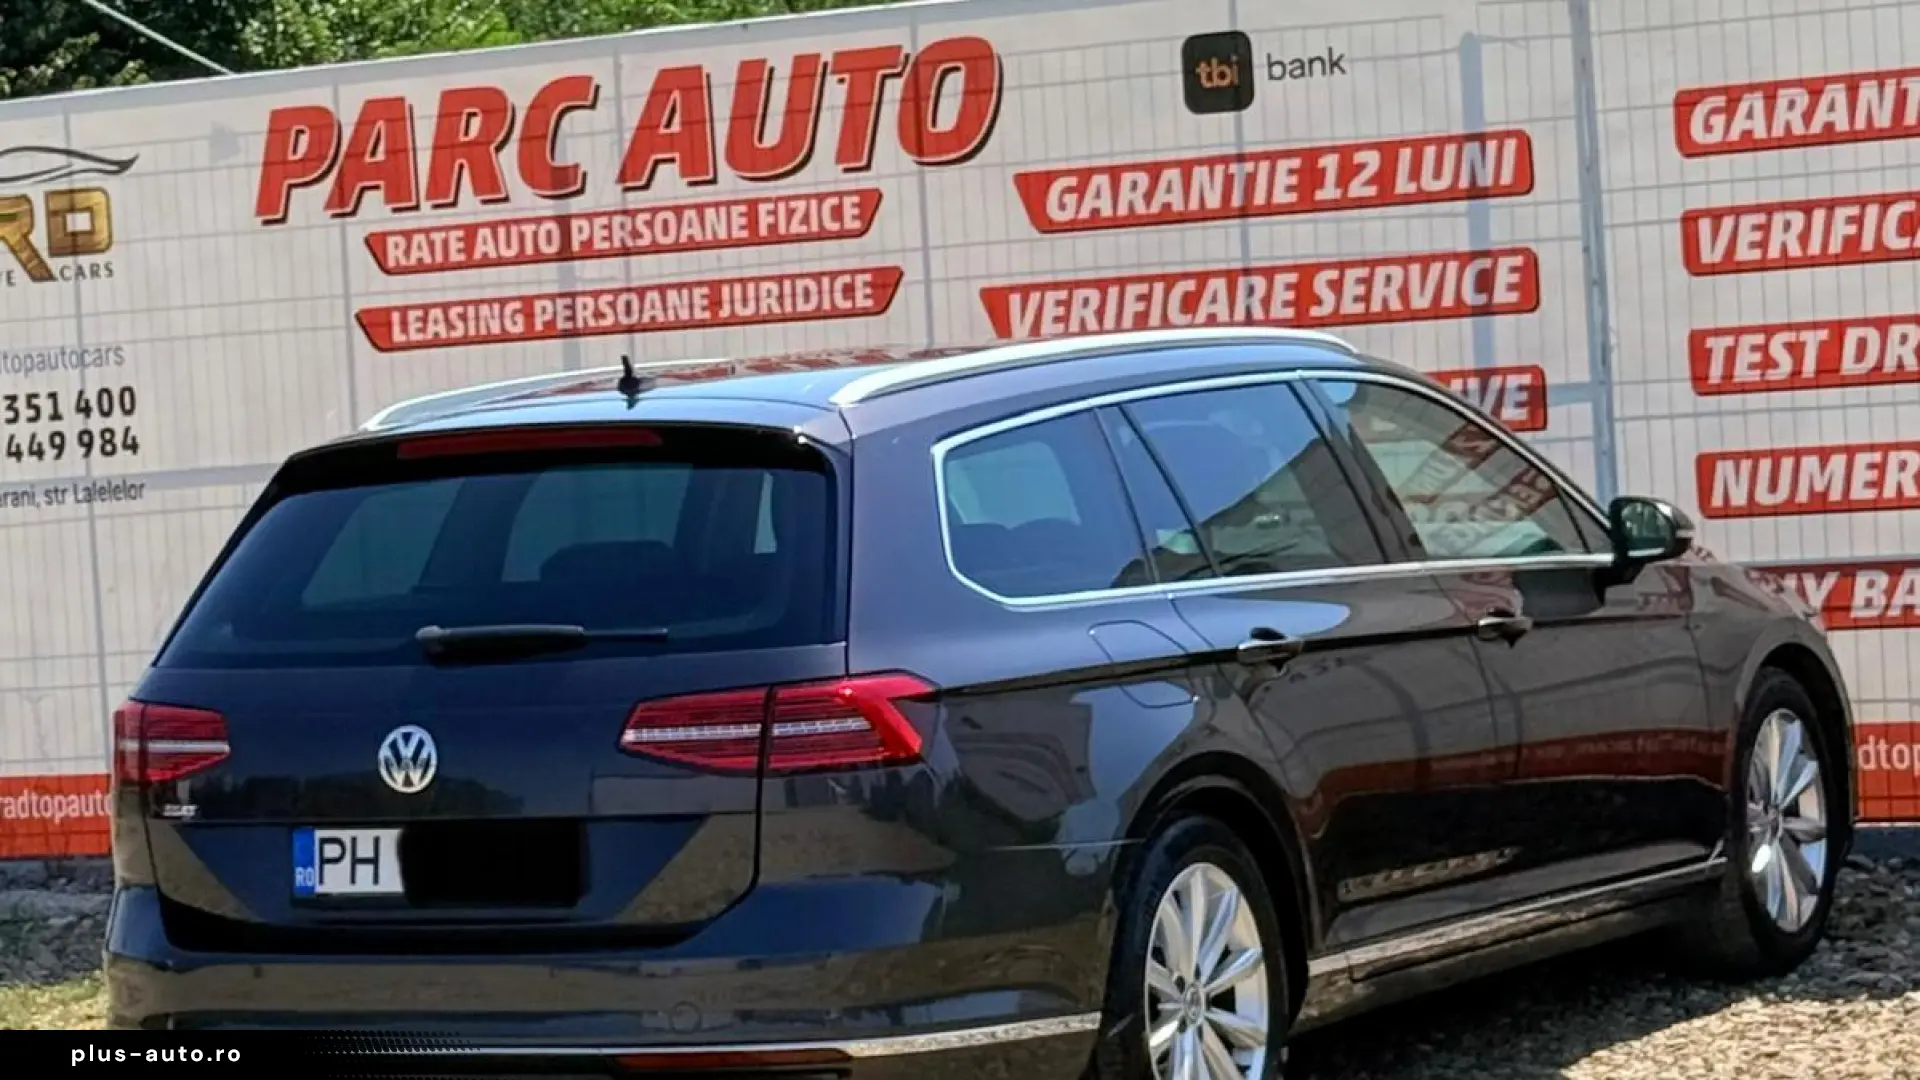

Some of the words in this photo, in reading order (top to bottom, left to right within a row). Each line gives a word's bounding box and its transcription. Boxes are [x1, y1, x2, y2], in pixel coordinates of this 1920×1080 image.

[1196, 56, 1239, 89] tbi
[1267, 46, 1347, 81] bank
[254, 75, 602, 225] PARC
[615, 36, 1003, 192] AUTO
[1045, 157, 1302, 222] GARANTIE
[1313, 146, 1380, 201] 12
[1393, 136, 1518, 196] LUNI
[386, 230, 467, 268] RATE
[473, 220, 561, 261] AUTO
[571, 203, 750, 252] PERSOANE
[758, 195, 864, 235] FIZICE
[1697, 200, 1920, 265] VERIFIC
[59, 260, 114, 282] CARS
[1007, 273, 1301, 338] VERIFICARE
[1309, 256, 1525, 318] SERVICE
[390, 300, 526, 345] LEASING
[534, 284, 710, 332] PERSOANE
[718, 272, 875, 319] JURIDICE
[0, 345, 126, 378] topautocars
[1704, 327, 1829, 387] TEST
[1839, 322, 1920, 377] DR
[3, 390, 64, 424] 351
[75, 385, 137, 421] 400
[5, 431, 68, 463] 449
[76, 425, 140, 459] 984
[0, 484, 41, 510] rani,
[44, 485, 68, 506] str
[1710, 448, 1920, 508] NUMER
[295, 866, 315, 887] RO
[319, 836, 380, 885] PH
